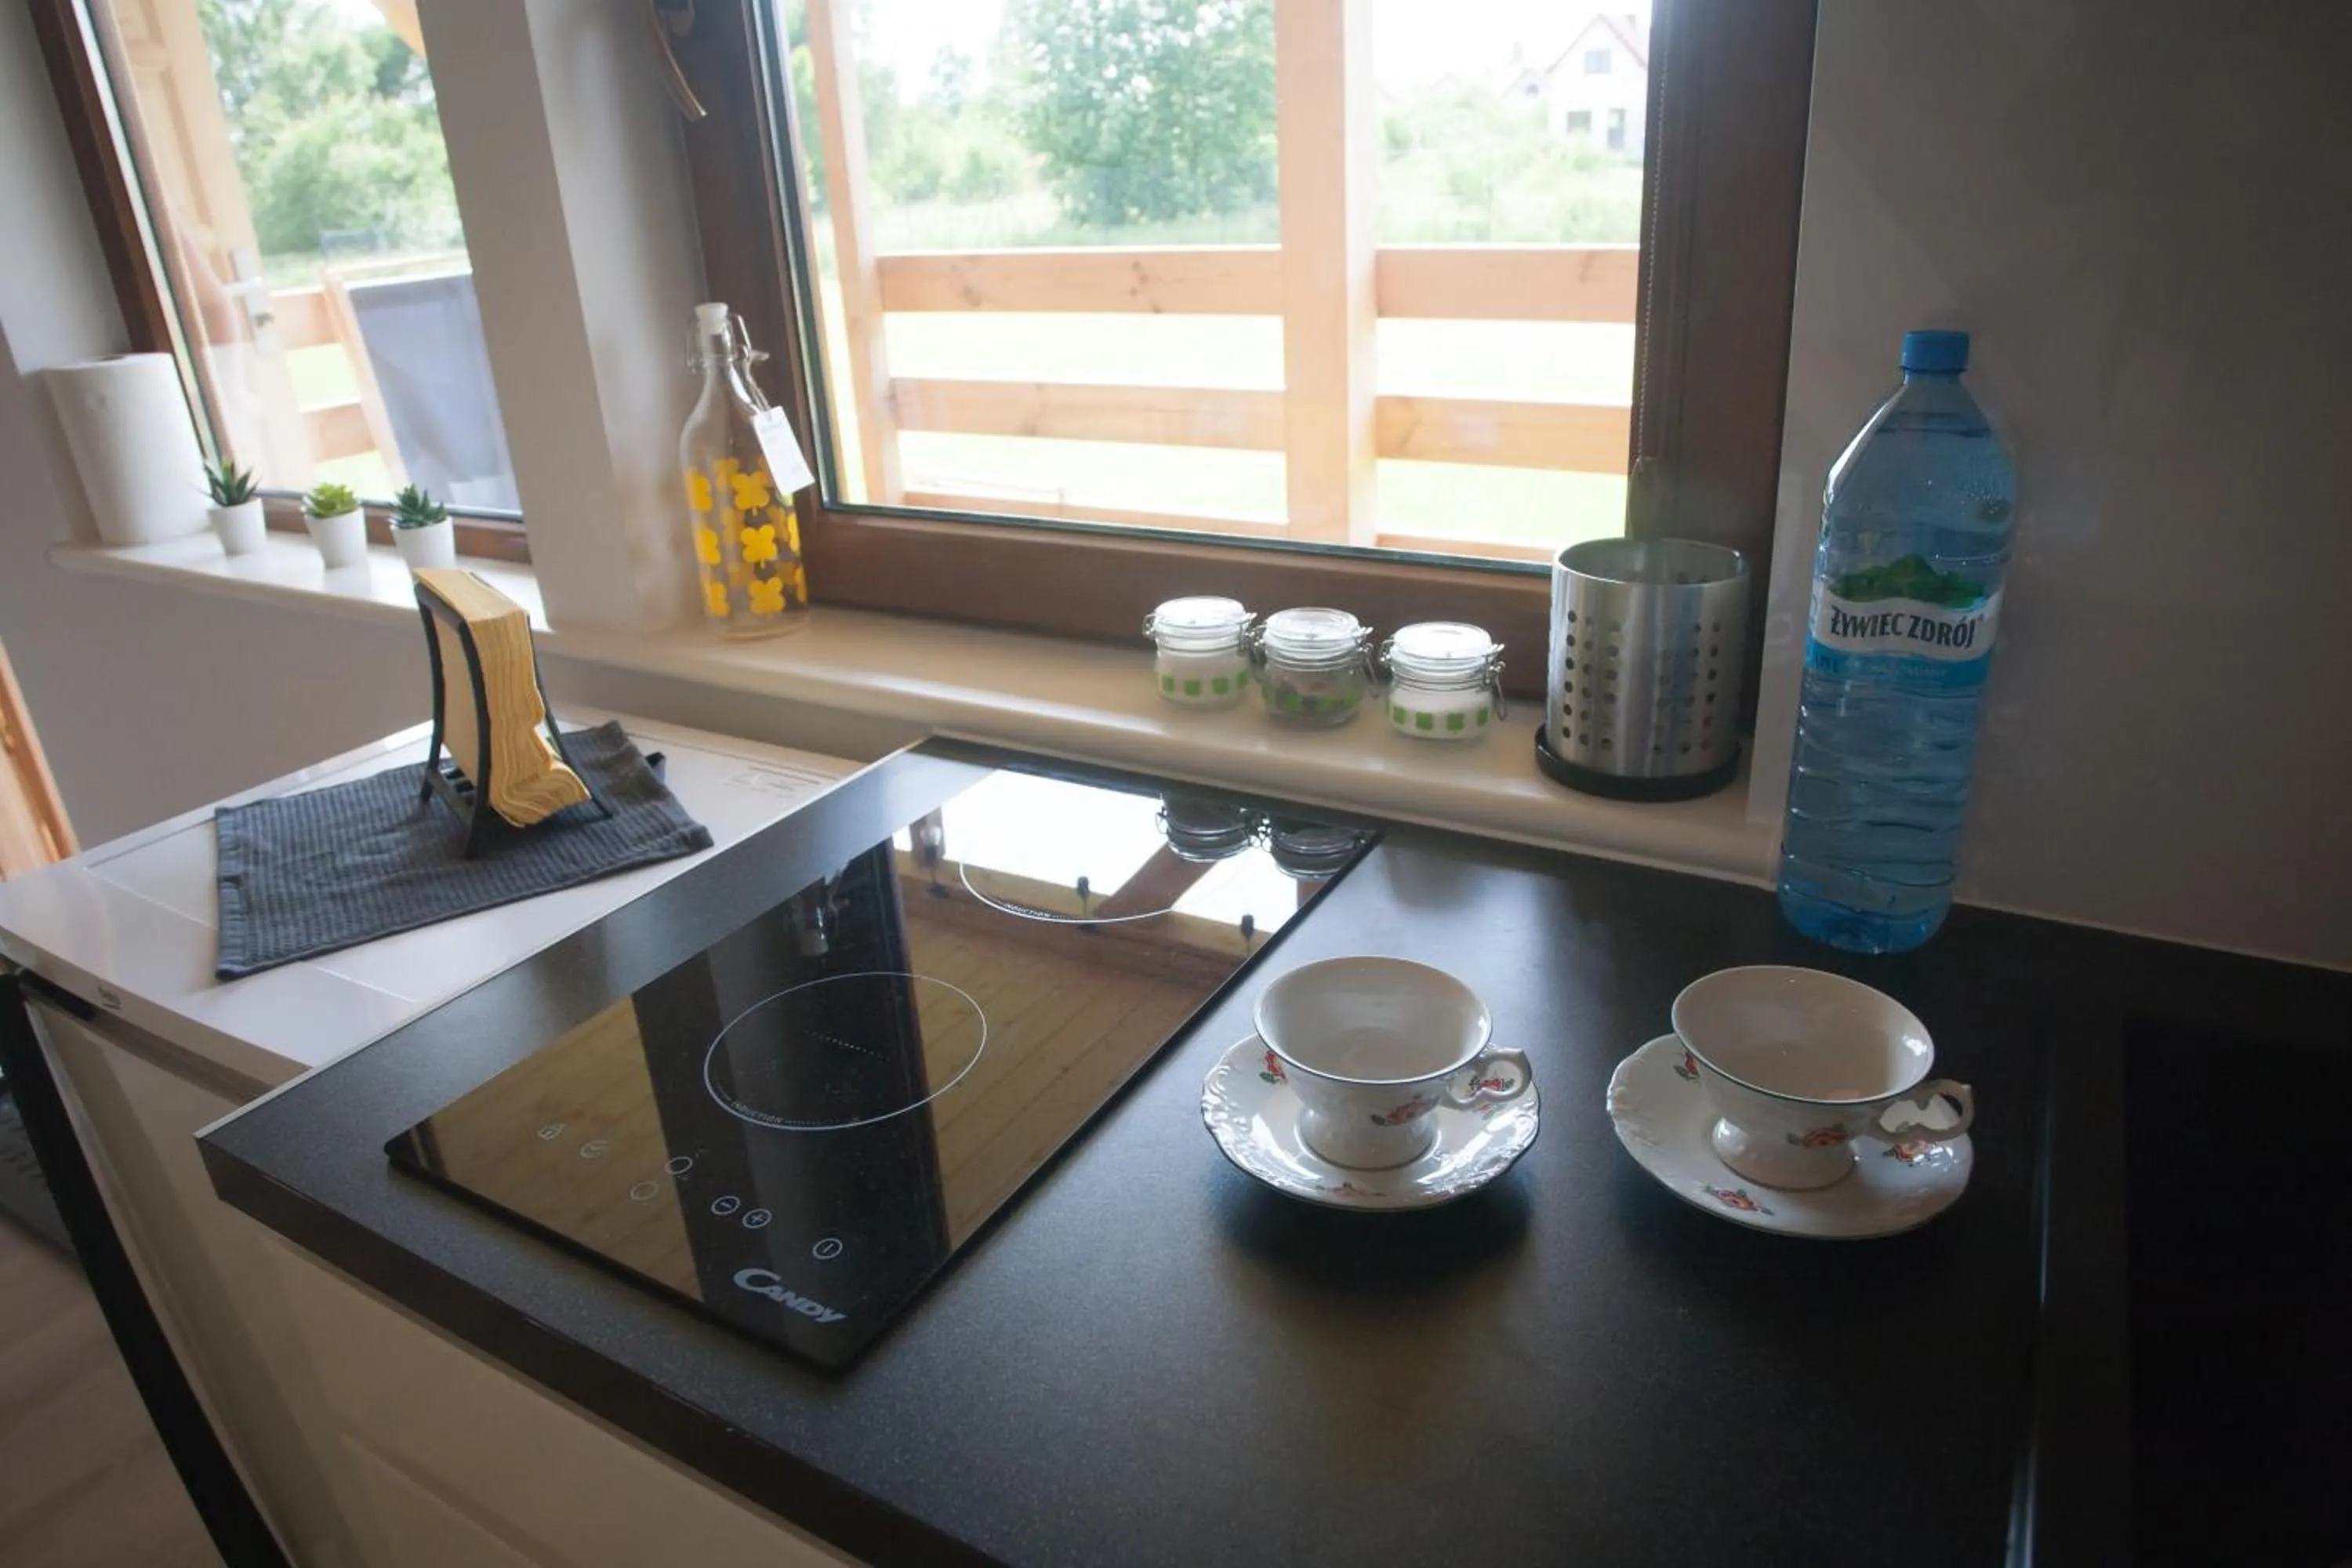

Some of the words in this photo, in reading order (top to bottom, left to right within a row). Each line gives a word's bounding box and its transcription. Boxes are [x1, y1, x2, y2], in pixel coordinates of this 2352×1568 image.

[1830, 604, 1904, 638] ŻYWIEC
[1908, 614, 1976, 648] ZDRÓJ
[733, 1268, 848, 1323] CANDY
